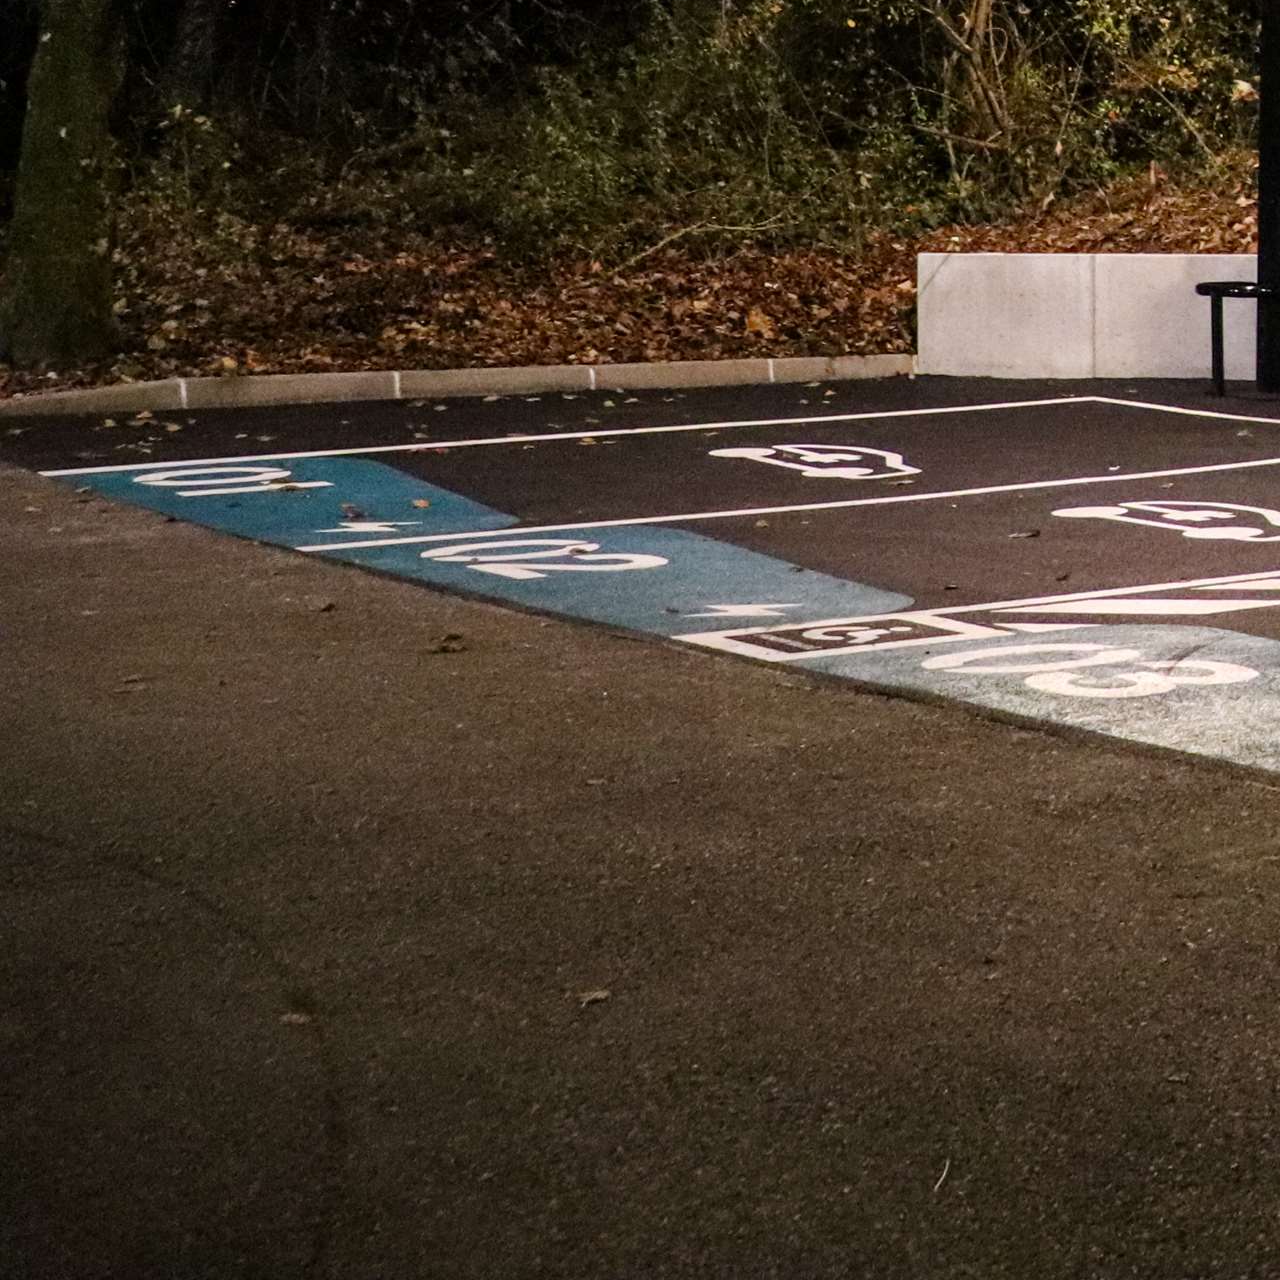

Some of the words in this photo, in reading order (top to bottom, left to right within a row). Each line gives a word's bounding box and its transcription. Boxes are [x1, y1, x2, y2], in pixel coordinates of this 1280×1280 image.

[132, 466, 335, 497] 01
[419, 539, 669, 580] 02
[920, 642, 1260, 698] 03
